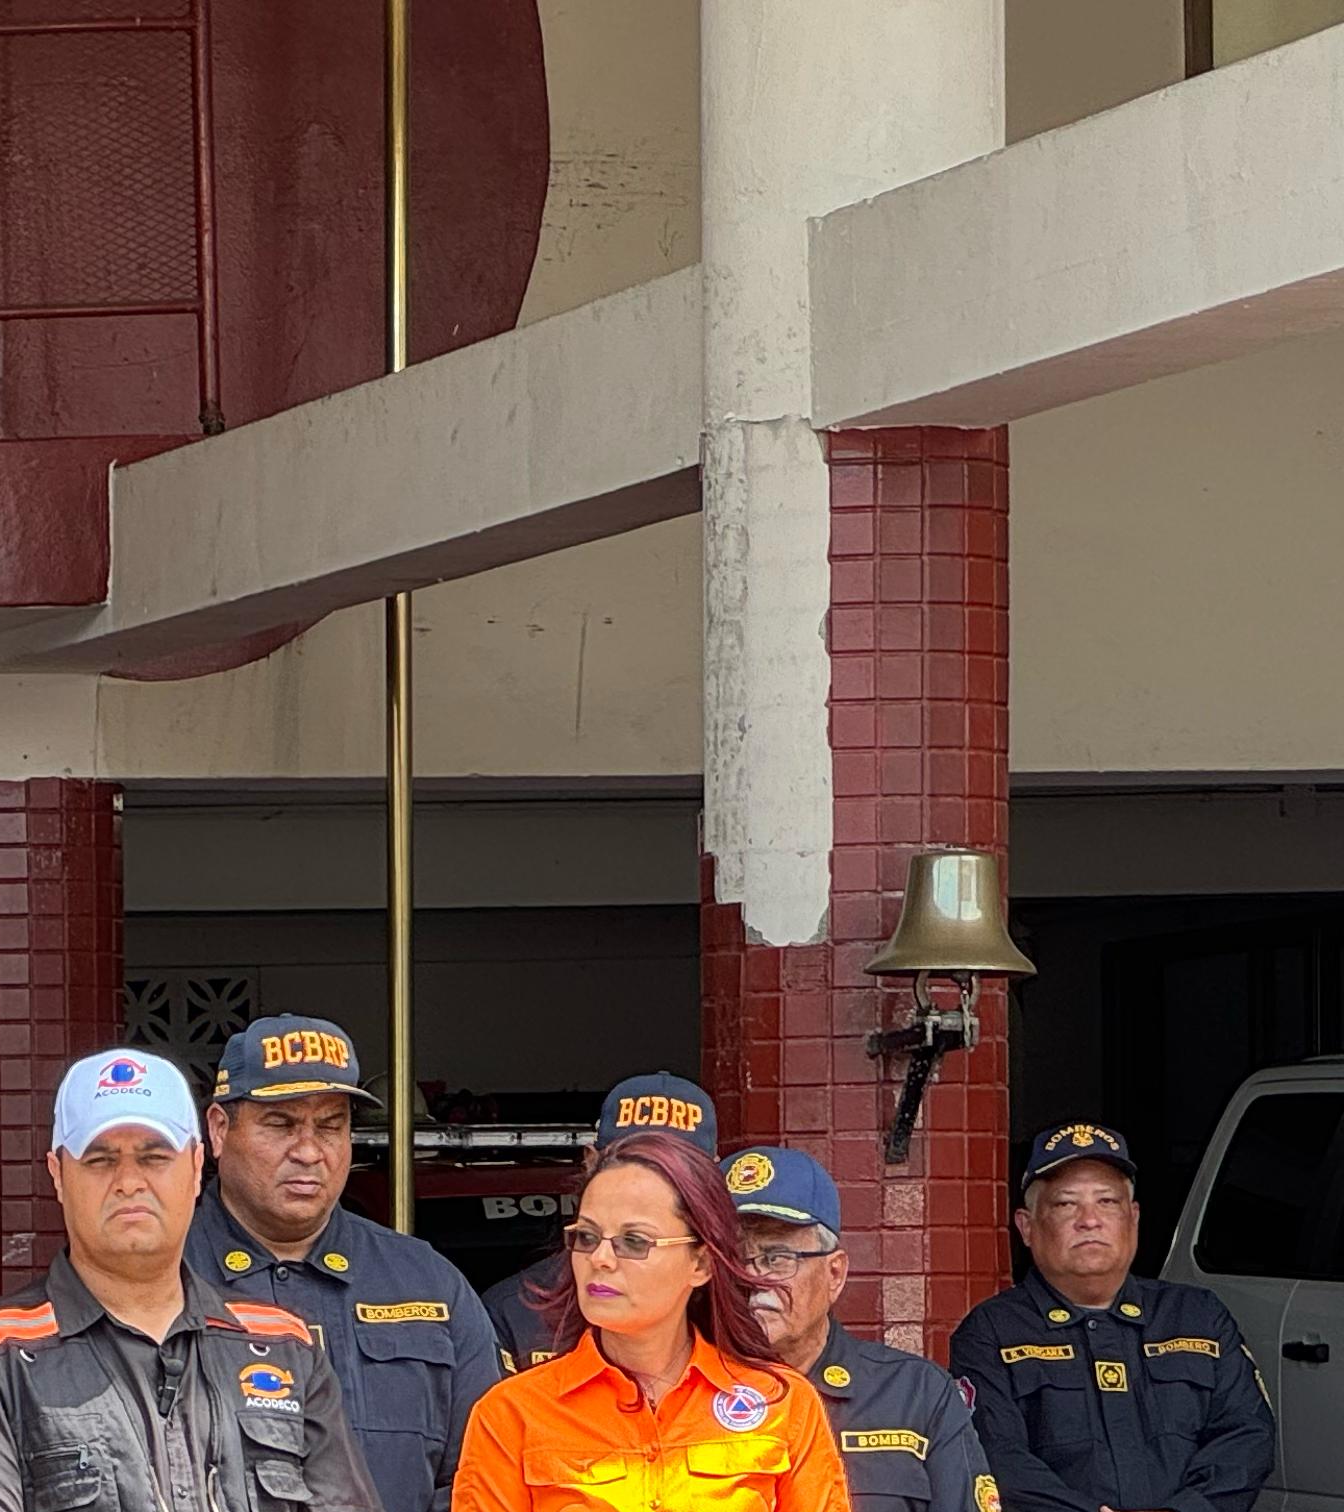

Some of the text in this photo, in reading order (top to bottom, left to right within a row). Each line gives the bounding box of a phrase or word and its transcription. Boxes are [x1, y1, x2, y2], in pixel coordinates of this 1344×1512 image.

[261, 1030, 350, 1069] BCBRP
[94, 1087, 152, 1100] ACODECO
[615, 1096, 703, 1132] BCBRP
[1044, 1125, 1120, 1151] BOMBEROS
[366, 1305, 438, 1320] BOMBEROS
[246, 1397, 300, 1412] ACODECO
